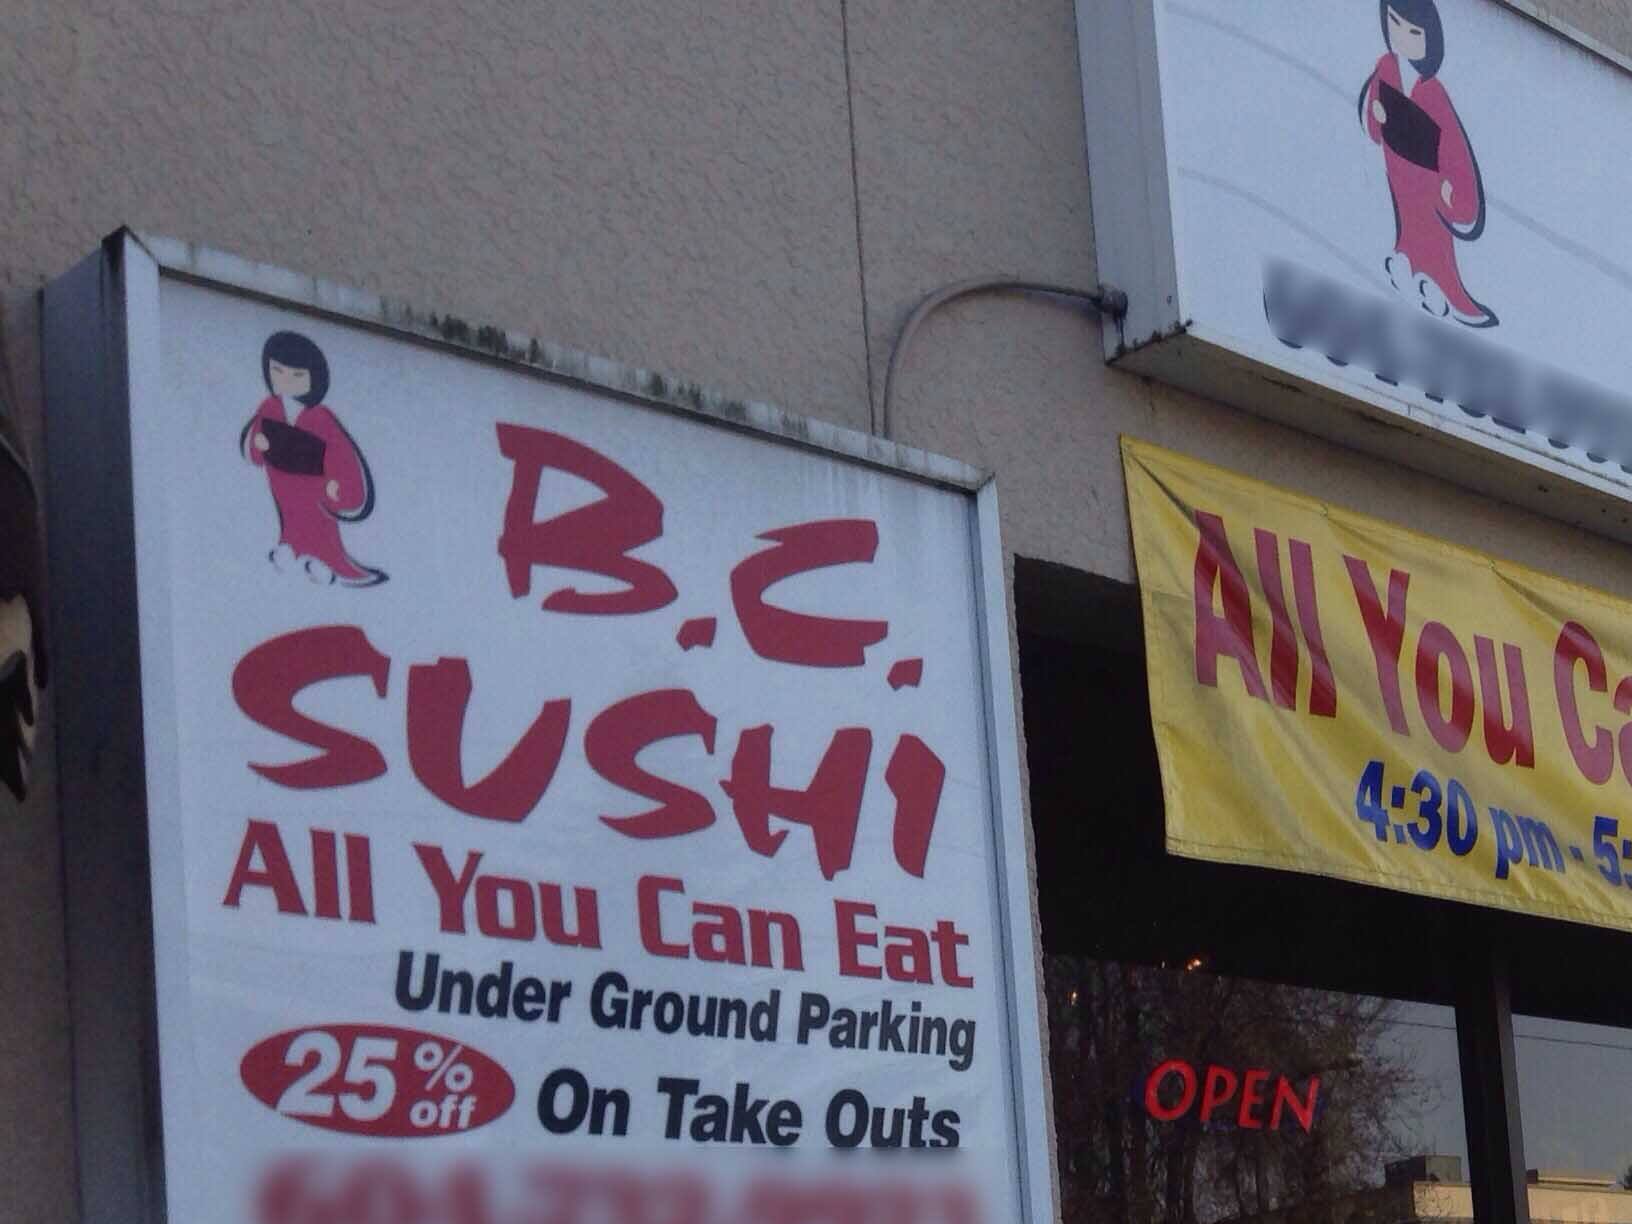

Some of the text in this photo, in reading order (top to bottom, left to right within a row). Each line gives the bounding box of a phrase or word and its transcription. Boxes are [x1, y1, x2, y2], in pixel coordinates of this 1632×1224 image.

[494, 420, 924, 690] B.C.
[1193, 510, 1336, 718] All
[1342, 554, 1535, 769] You
[231, 625, 946, 880] SUSHI
[1356, 760, 1478, 856] 4:30
[1488, 807, 1566, 880] pm
[223, 820, 974, 989] All You Can Eat
[395, 952, 976, 1072] Under Ground Parking
[410, 1094, 477, 1128] off
[537, 1068, 962, 1148] On Take Outs
[1144, 1058, 1321, 1135] OPEN
